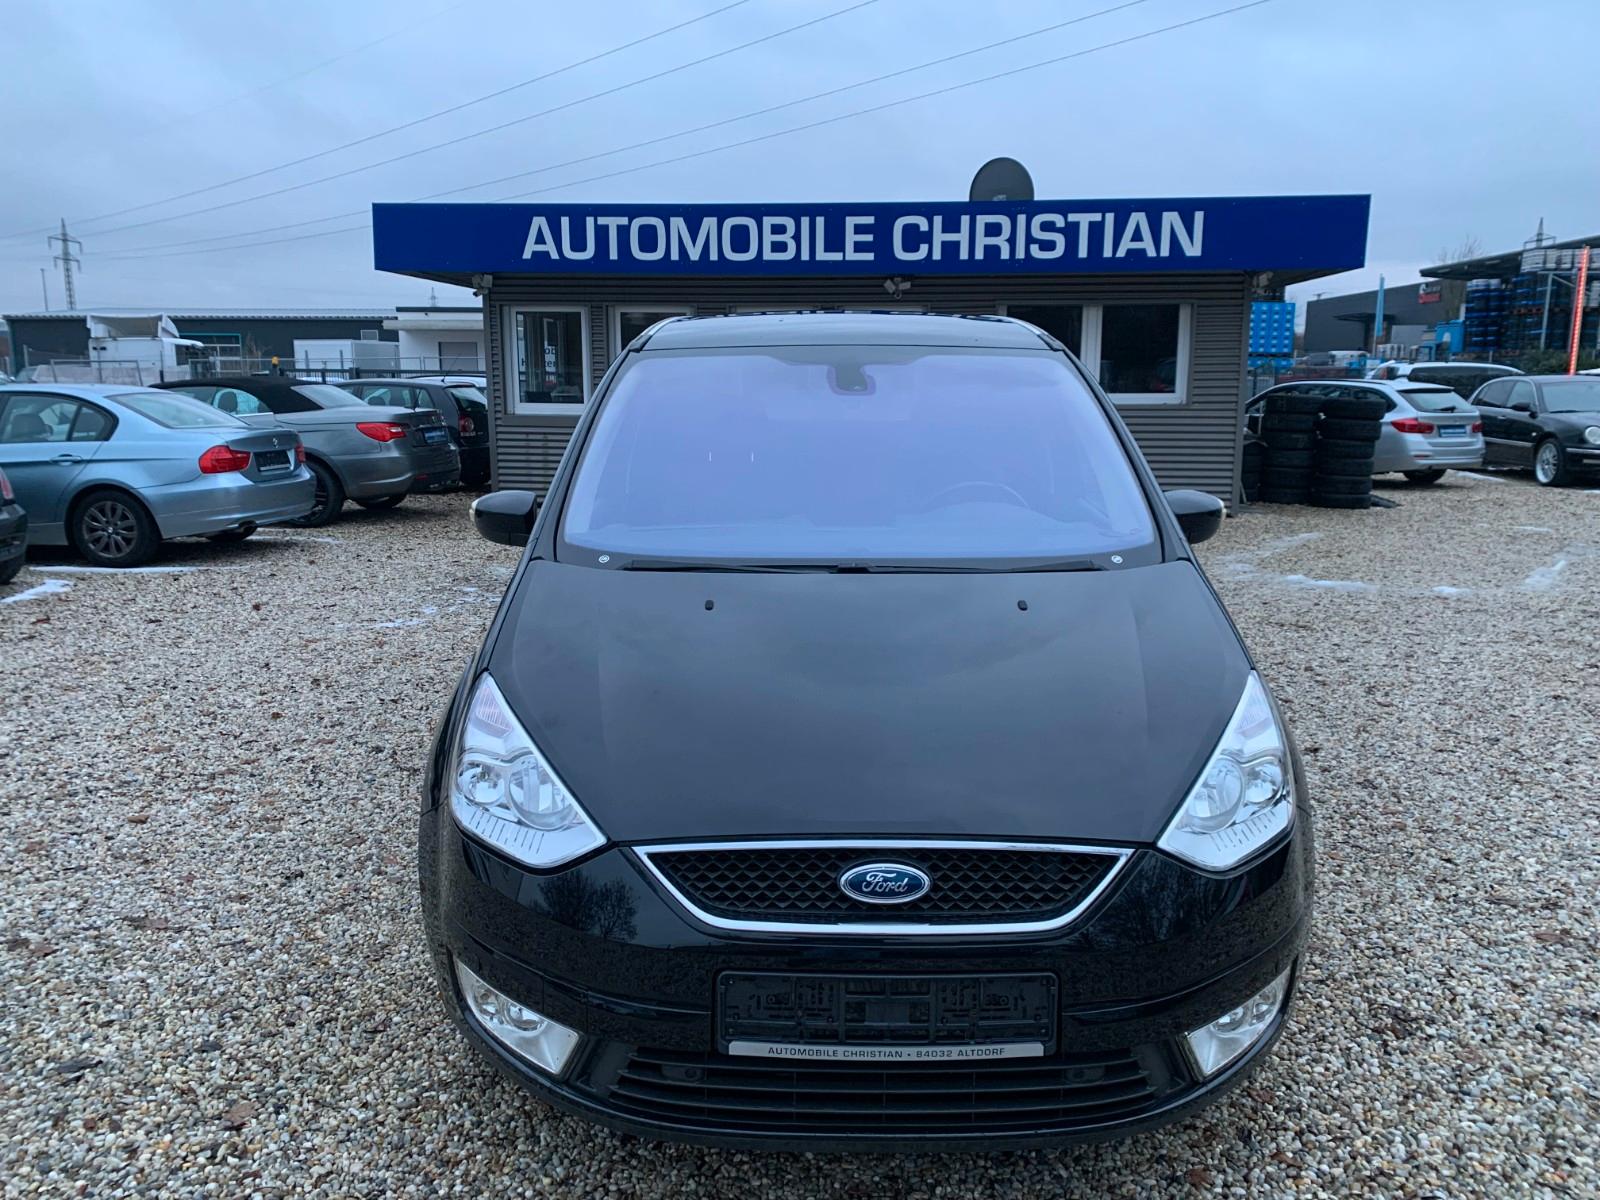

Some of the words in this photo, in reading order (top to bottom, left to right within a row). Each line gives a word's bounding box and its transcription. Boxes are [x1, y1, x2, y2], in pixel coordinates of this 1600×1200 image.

[522, 216, 875, 261] AUTOMOBILE
[893, 212, 1204, 261] CHRISTIAN
[861, 872, 908, 893] Ford
[768, 1047, 838, 1057] AUTOMOBILE
[843, 1049, 903, 1059] CHRISTIAN
[916, 1050, 953, 1058] 84032
[957, 1048, 1005, 1057] ALTDORF
